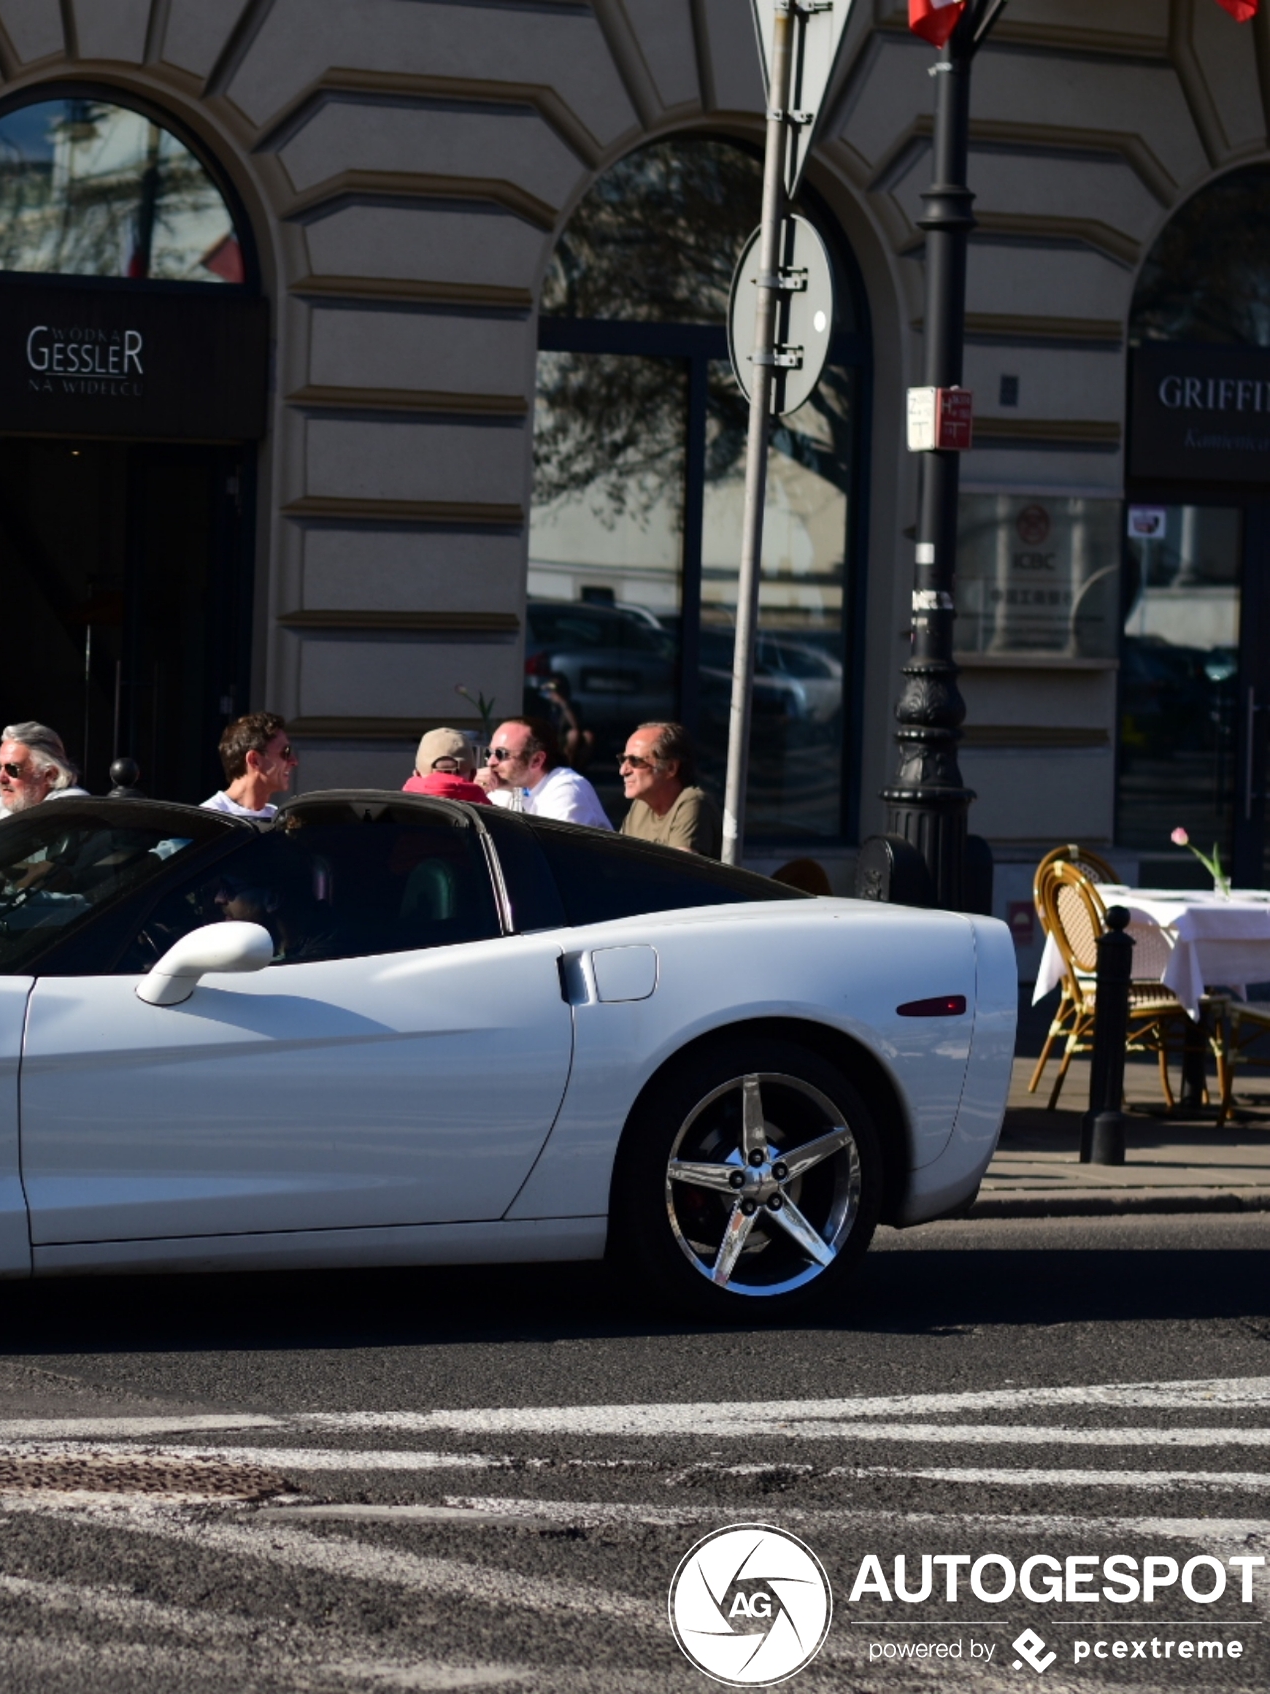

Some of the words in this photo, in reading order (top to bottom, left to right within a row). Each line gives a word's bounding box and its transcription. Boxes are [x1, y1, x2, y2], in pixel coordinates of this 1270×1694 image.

[51, 325, 121, 343] WÓDKA
[26, 325, 144, 374] GESSLER
[28, 379, 53, 392] NA
[1158, 374, 1270, 413] GRIFFI
